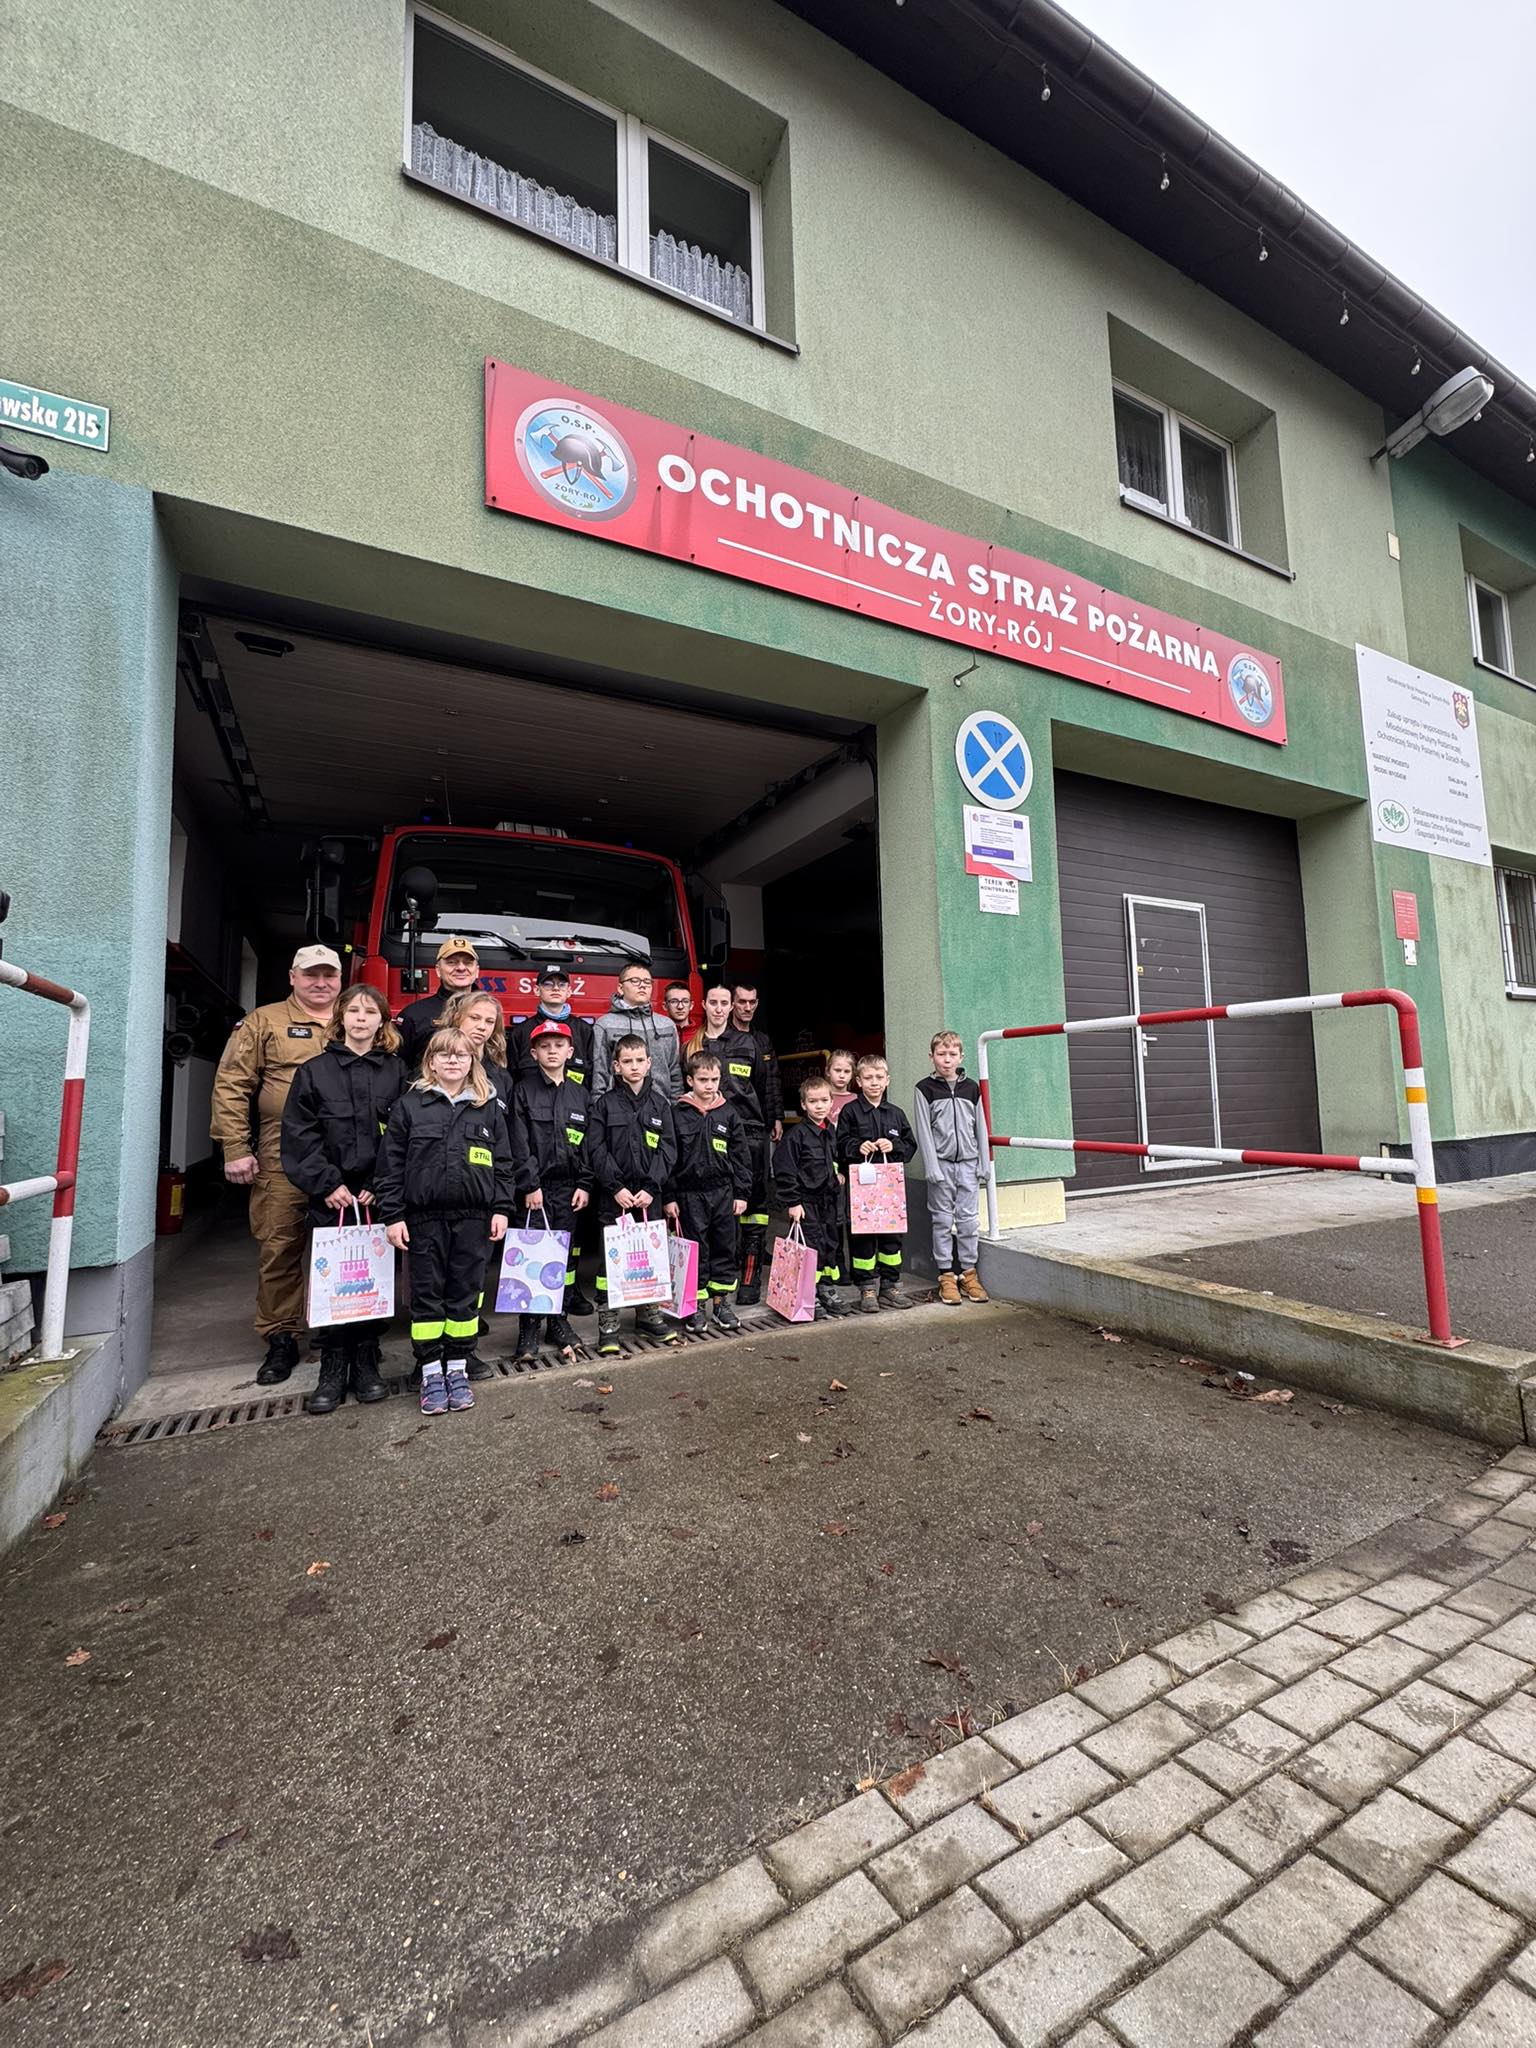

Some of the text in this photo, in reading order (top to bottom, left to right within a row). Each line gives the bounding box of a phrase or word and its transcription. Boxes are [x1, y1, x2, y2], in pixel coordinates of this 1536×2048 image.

[63, 406, 99, 439] 215
[658, 454, 1220, 678] OCHOTNICZA STRAŻ POŻARNA
[928, 591, 1053, 653] ŻORY-RÓJ
